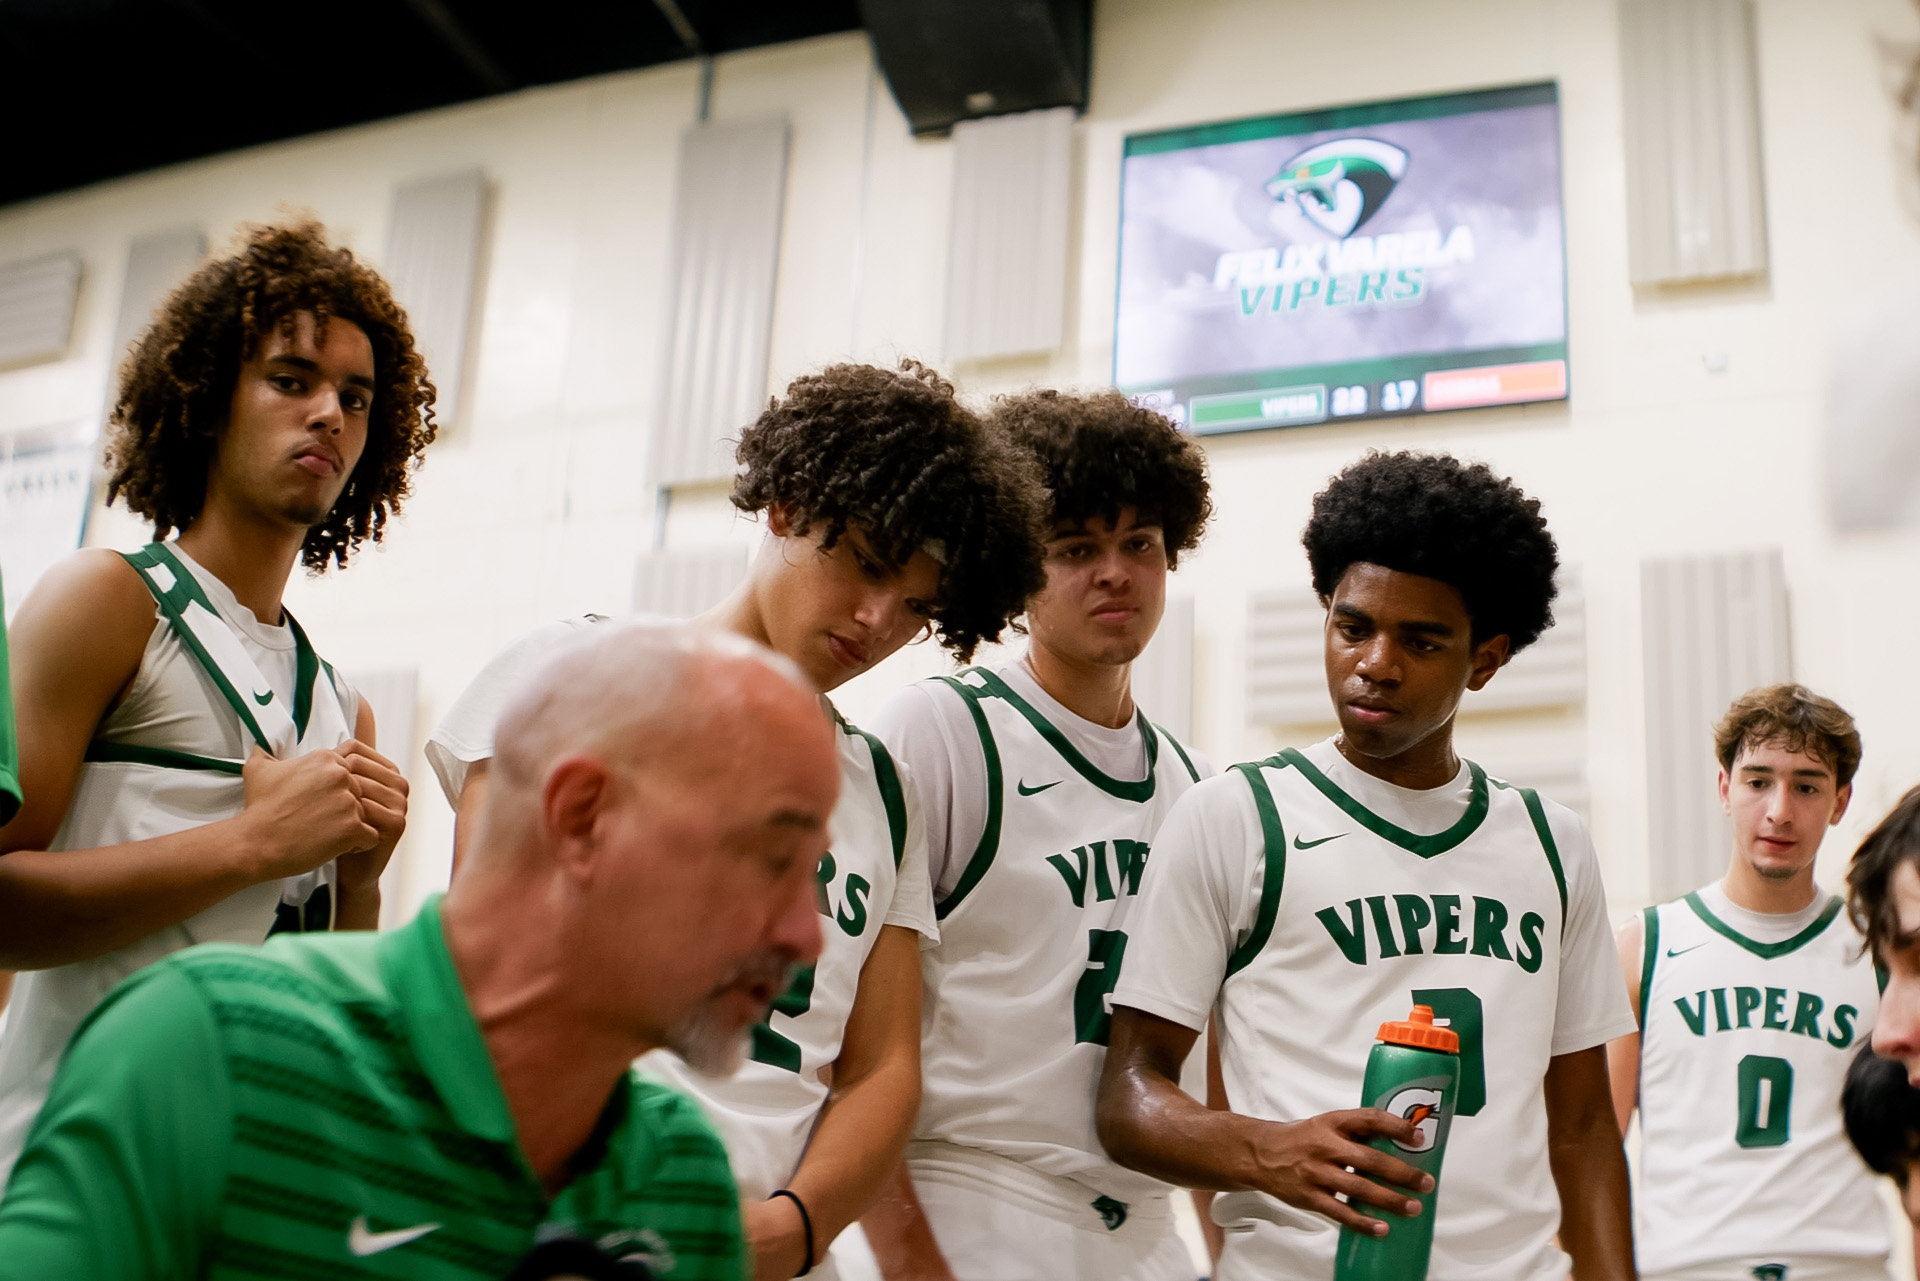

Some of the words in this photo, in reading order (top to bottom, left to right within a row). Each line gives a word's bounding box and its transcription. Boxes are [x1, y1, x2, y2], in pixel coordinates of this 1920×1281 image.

[1214, 243, 1322, 290] FELIX
[1328, 225, 1474, 273] VARELA
[1240, 266, 1425, 317] VIPERS
[1315, 894, 1545, 973] VIPERS
[1673, 986, 1858, 1049] VIPERS
[1735, 1054, 1794, 1149] 0
